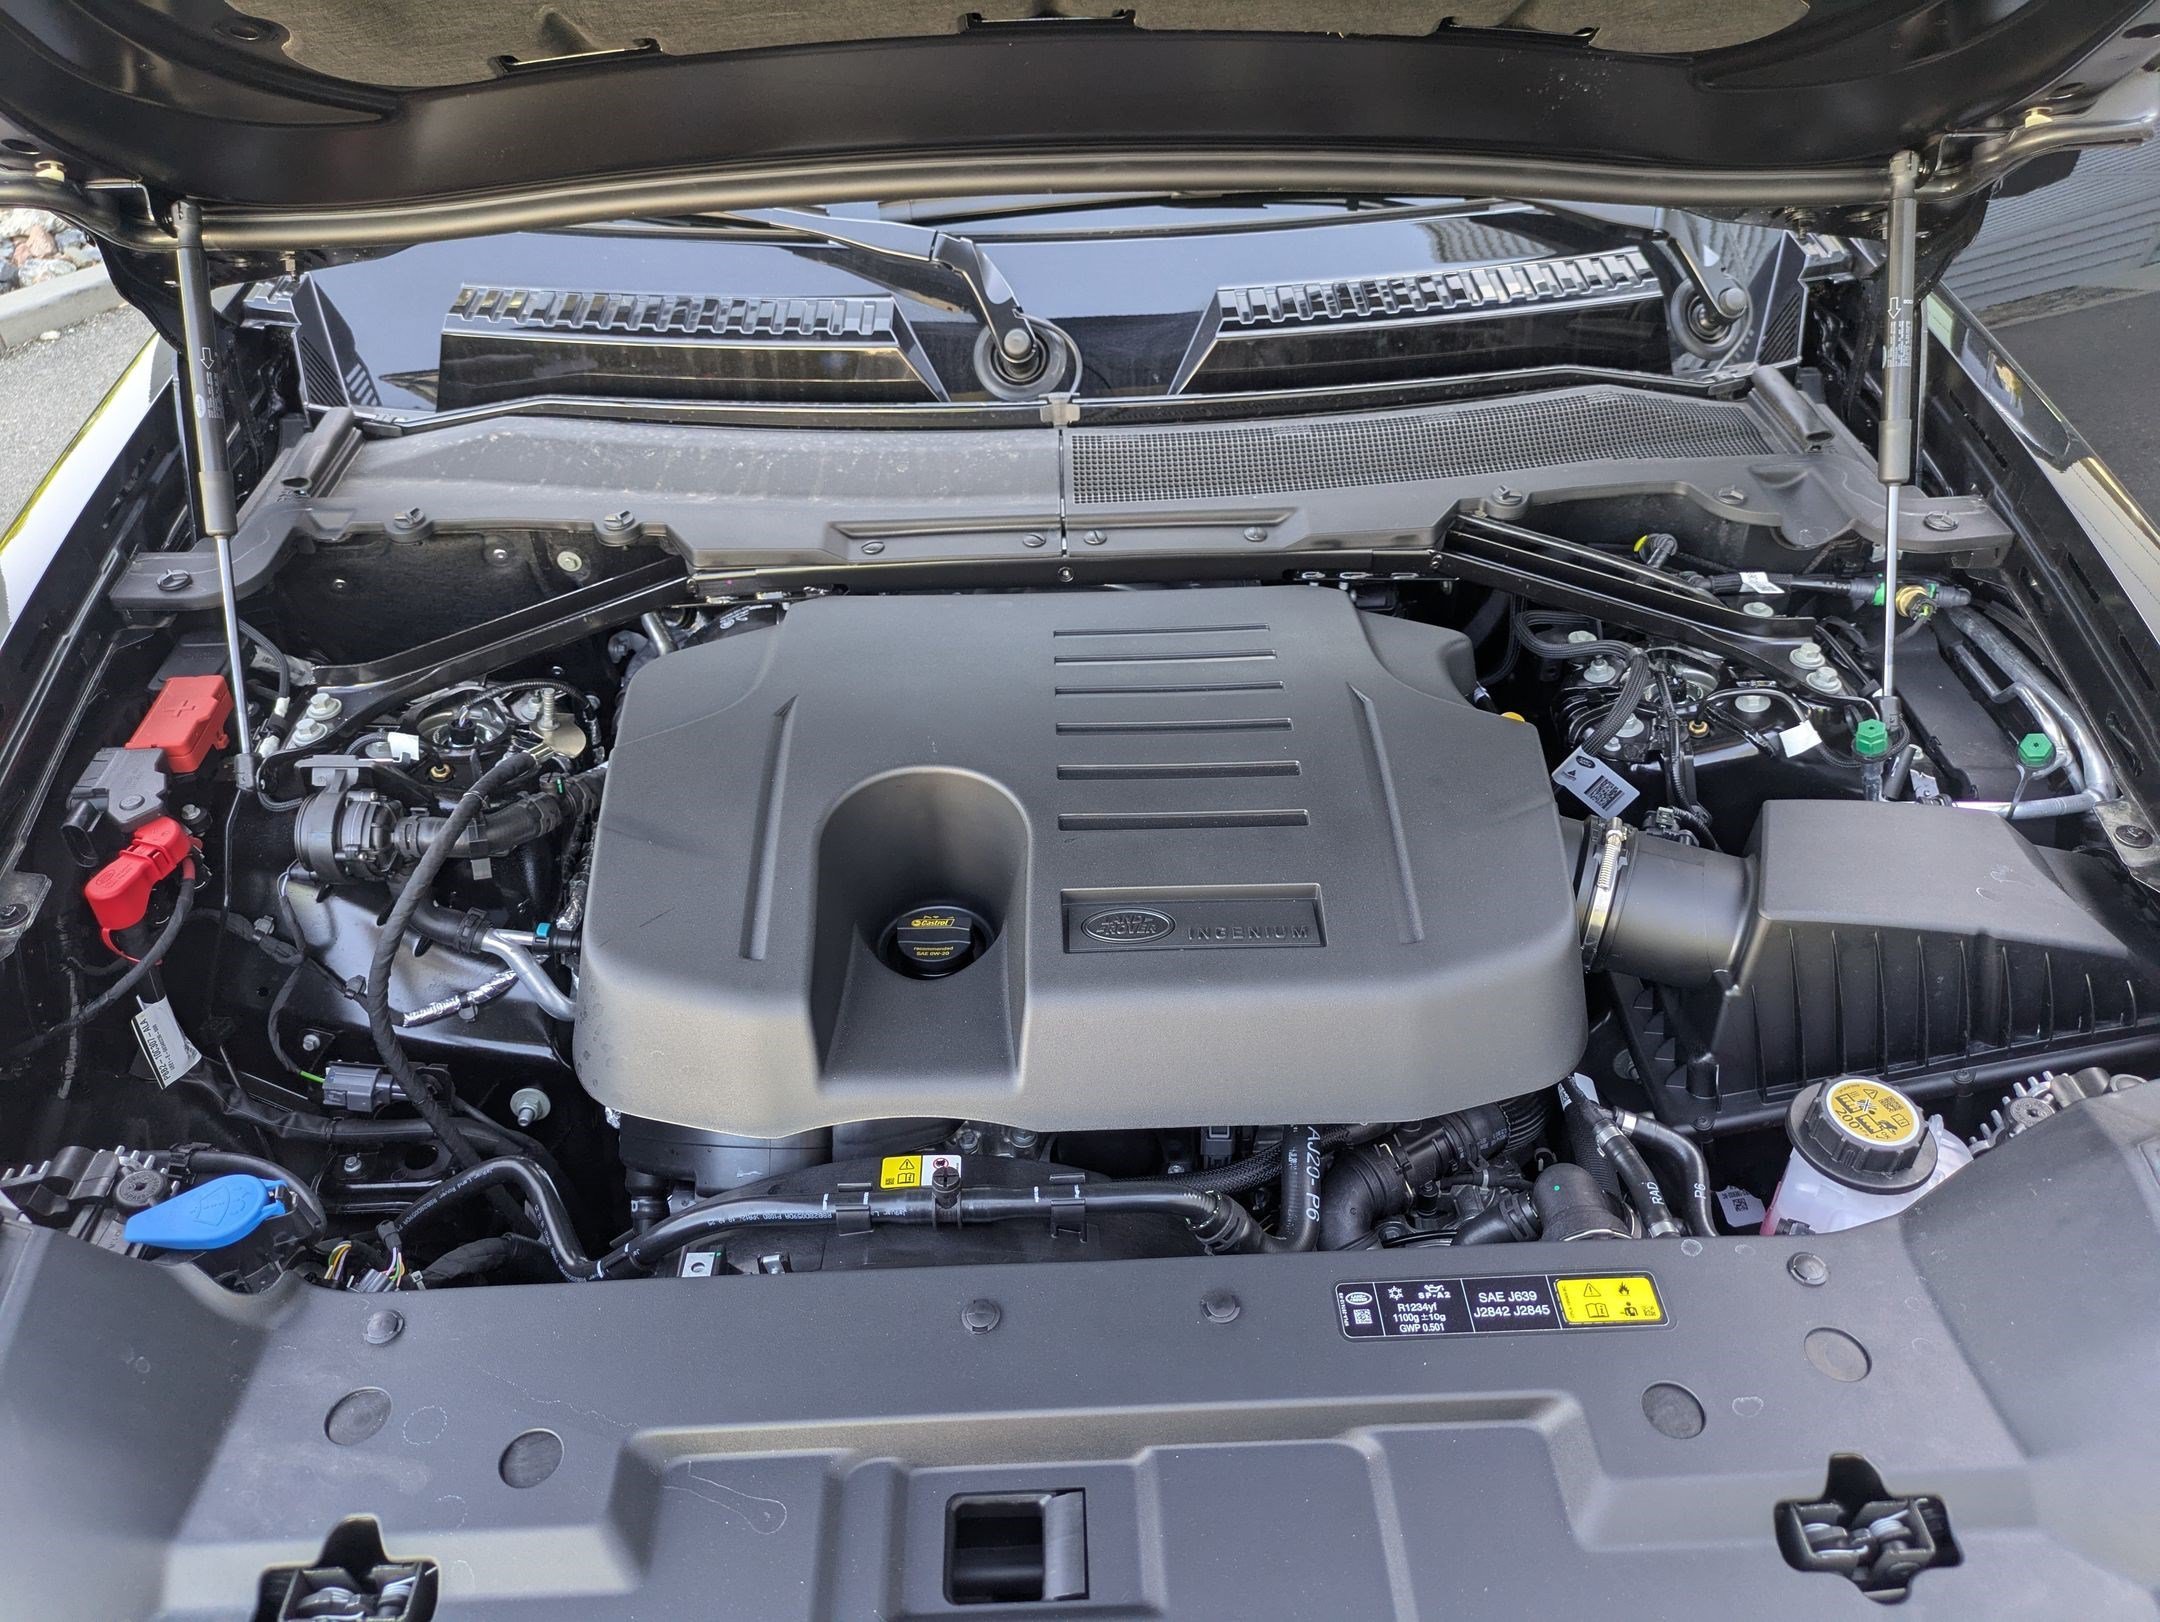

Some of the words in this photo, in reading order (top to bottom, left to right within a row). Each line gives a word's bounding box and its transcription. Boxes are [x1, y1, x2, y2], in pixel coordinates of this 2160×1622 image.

[921, 919, 950, 927] Castrol
[1188, 926, 1308, 940] INGENIUM
[1834, 1109, 1861, 1129] 200
[1646, 1181, 1664, 1205] RAD
[1693, 1183, 1706, 1199] P6
[1306, 1192, 1320, 1222] P6
[1418, 1291, 1451, 1299] SP-A2
[1478, 1292, 1505, 1303] SAE
[1508, 1290, 1538, 1302] J639
[1397, 1302, 1437, 1313] R1234yf
[1473, 1306, 1511, 1318] J2842
[1513, 1304, 1551, 1316] J2845
[1393, 1313, 1420, 1323] 1100g
[1421, 1312, 1447, 1322] ±10g
[1399, 1323, 1421, 1332] GWP
[1422, 1322, 1445, 1332] 0.501
